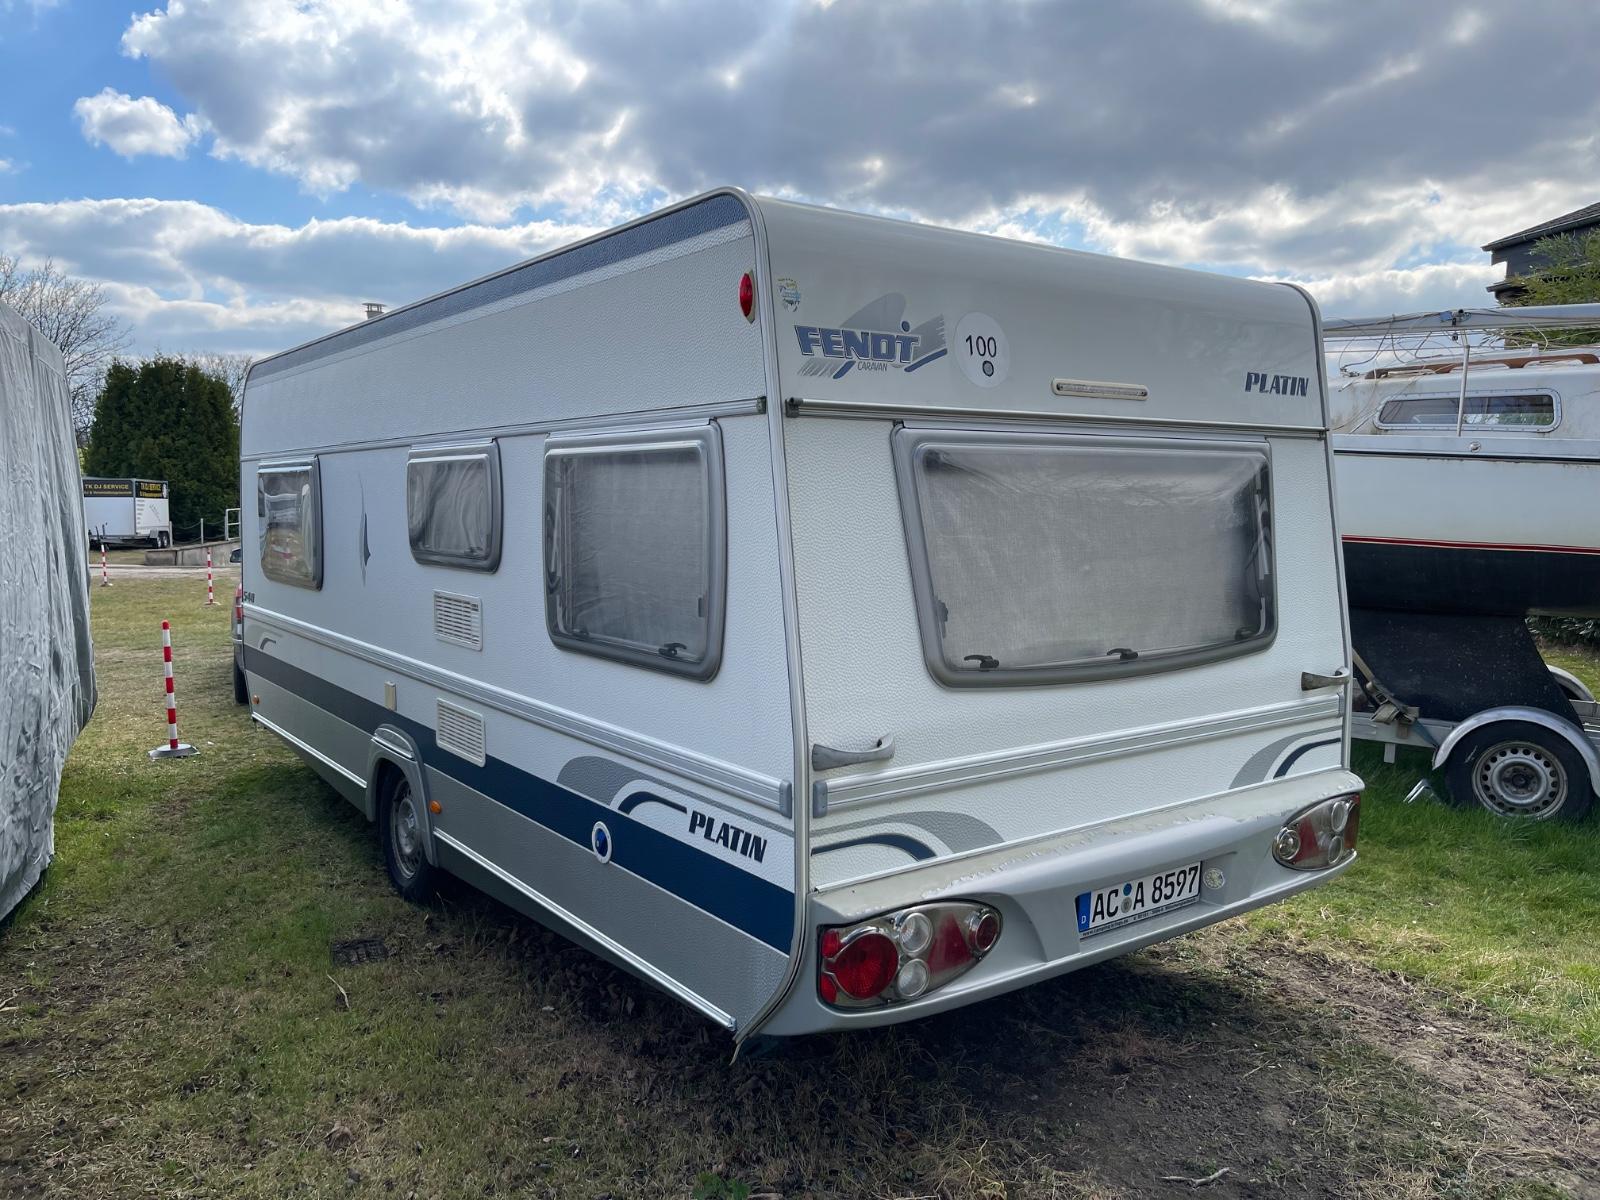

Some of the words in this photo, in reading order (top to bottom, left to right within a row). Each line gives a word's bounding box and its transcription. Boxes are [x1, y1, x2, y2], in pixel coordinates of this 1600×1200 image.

[794, 321, 920, 363] FENDT
[965, 334, 997, 358] 100
[857, 359, 888, 372] CARAVAN
[1245, 372, 1309, 397] PLATIN
[689, 810, 768, 863] PLATIN
[1092, 889, 1119, 922] AC
[1132, 881, 1145, 910] A
[1152, 865, 1199, 904] 8597
[1081, 915, 1087, 924] D
